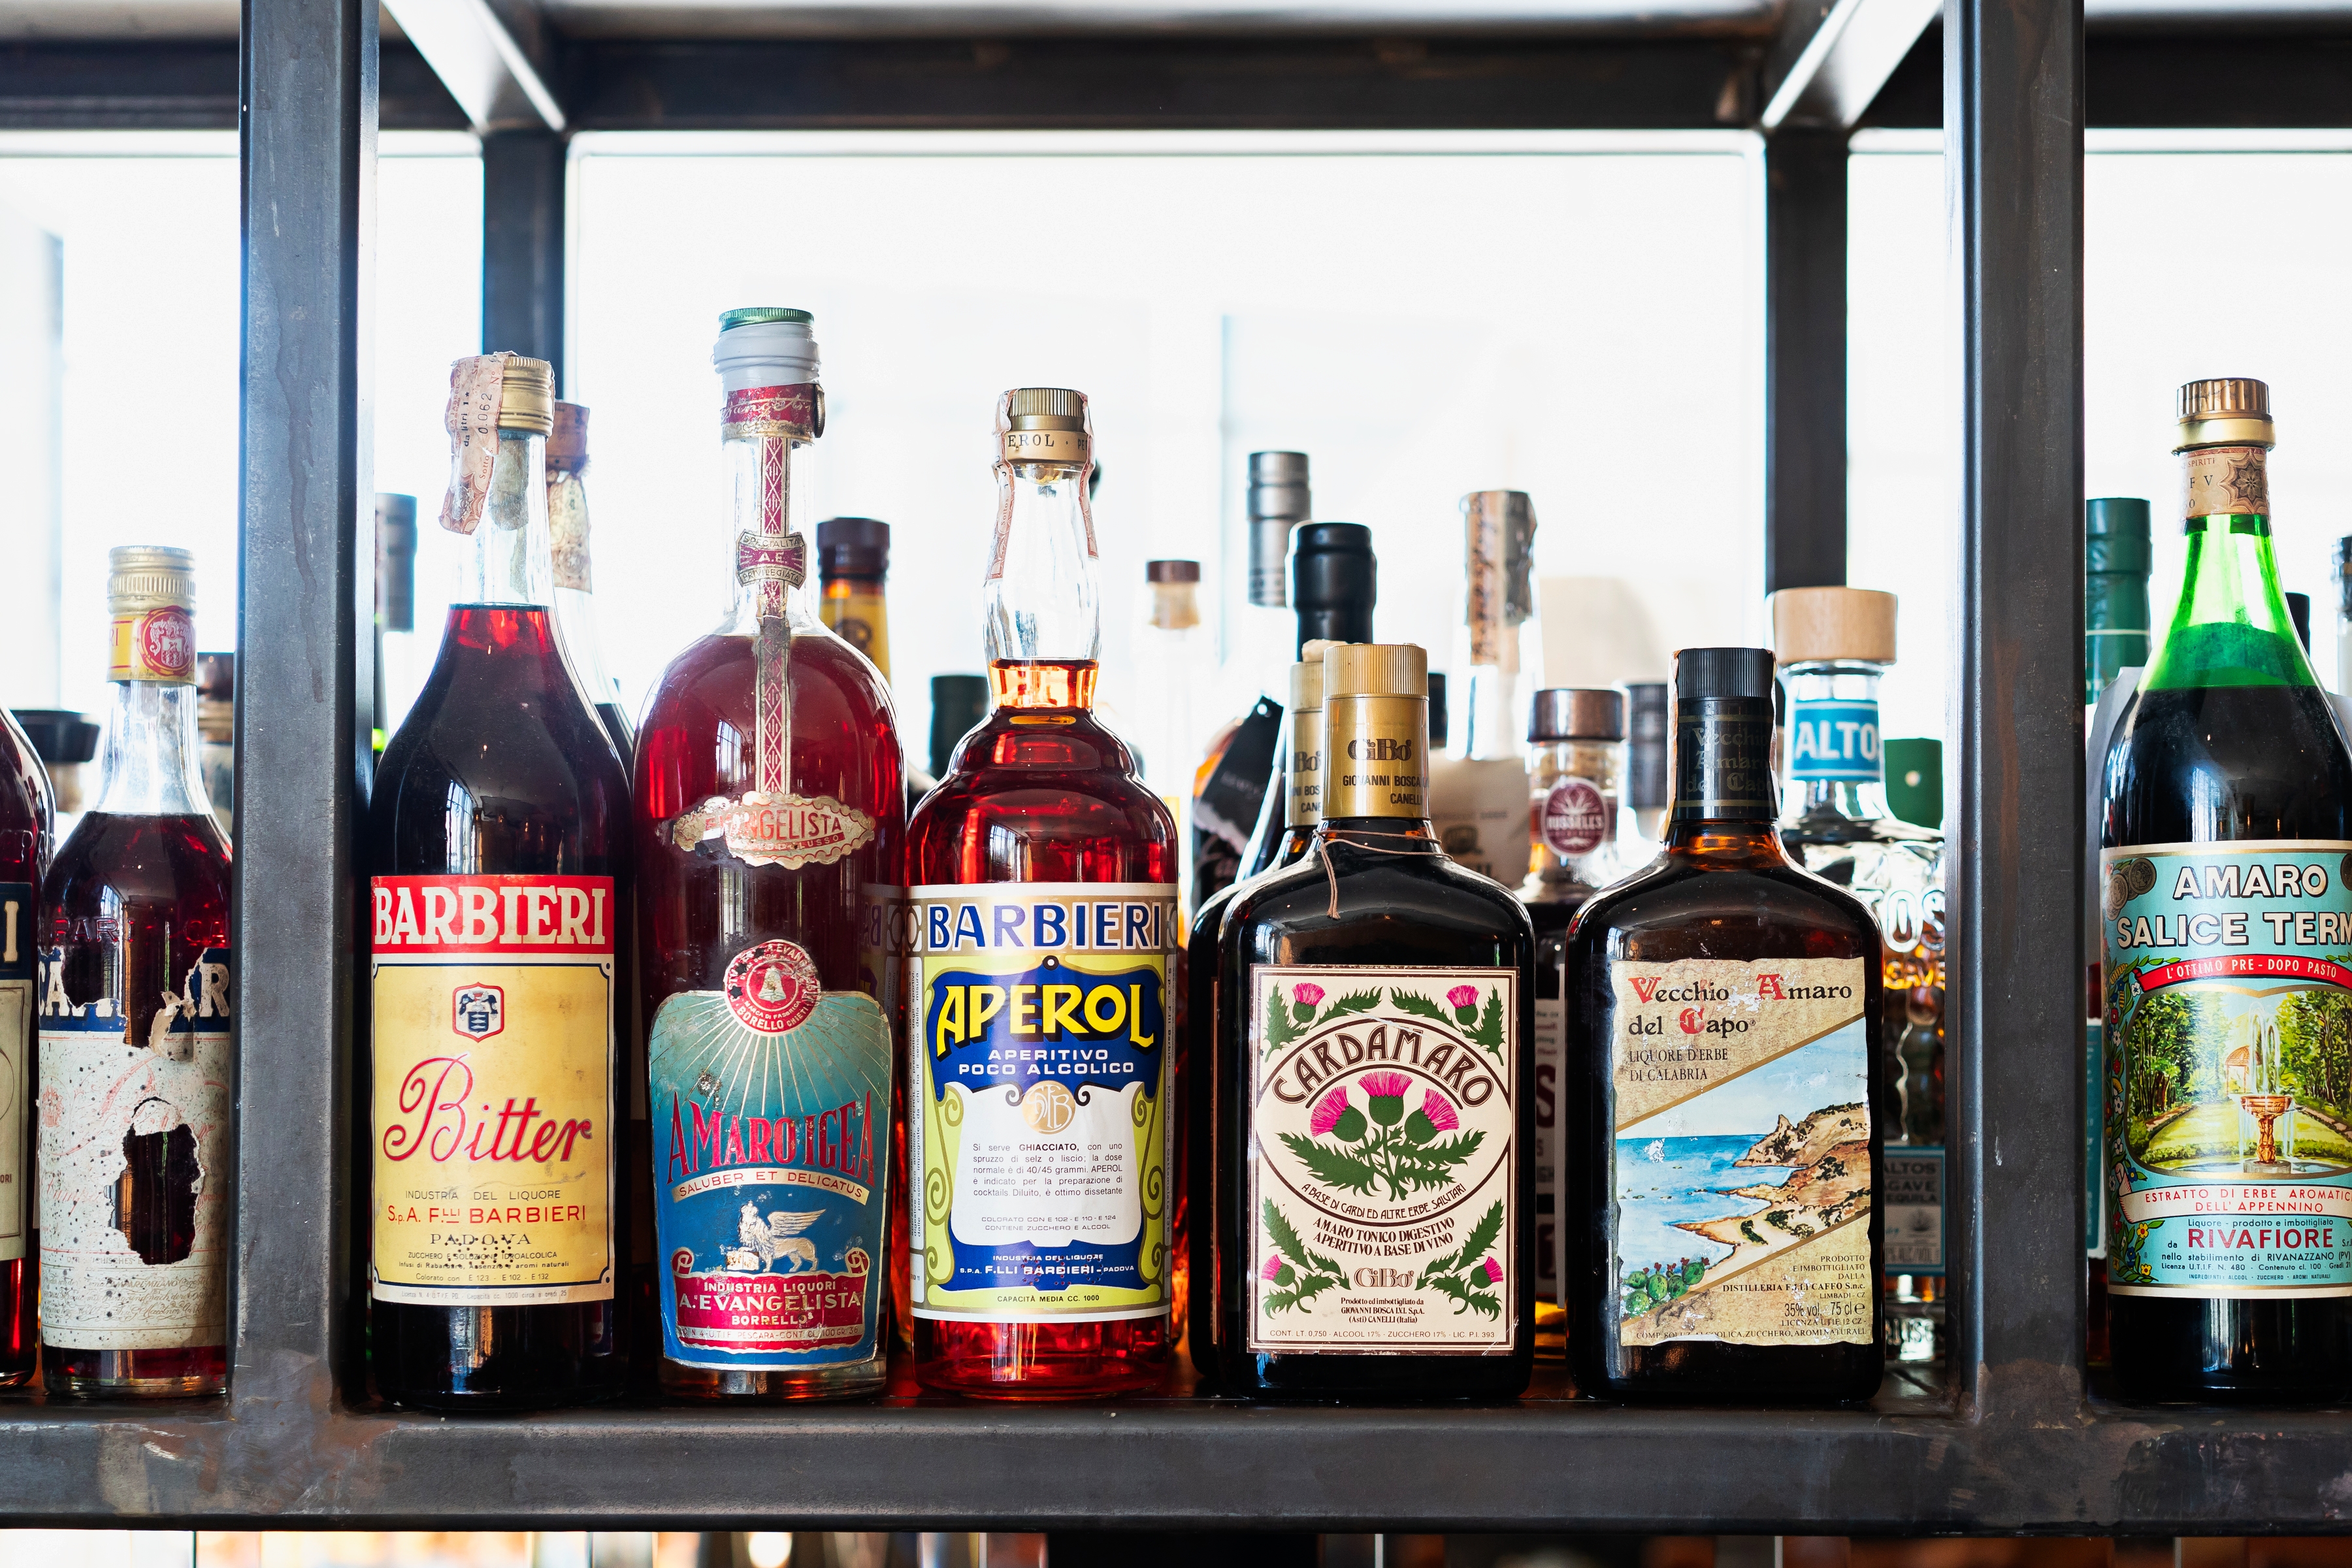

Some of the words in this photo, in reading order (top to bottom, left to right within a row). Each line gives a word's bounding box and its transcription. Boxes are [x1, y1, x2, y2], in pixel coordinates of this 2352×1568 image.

[1343, 775, 1390, 786] GIOVANNI
[2173, 864, 2328, 900] AMARO
[374, 885, 606, 945] BARBIERI
[928, 902, 1161, 951] BARBIERI
[2117, 913, 2249, 949] SALICE
[2167, 960, 2223, 979] L'OTTIMO
[2231, 959, 2254, 971] PRE
[2268, 959, 2300, 971] DOPO
[2307, 961, 2337, 979] PASTO
[1628, 977, 1729, 1004] Vecchio
[1756, 973, 1852, 1001] Amaro
[737, 1006, 784, 1030] BORELLO
[936, 984, 1154, 1057] APEROL
[1628, 1015, 1663, 1035] del
[988, 1049, 1108, 1061] APERITIVO
[1629, 1049, 1683, 1065] LIQUORE
[1688, 1048, 1728, 1060] D'ERBE
[959, 1064, 1016, 1075] POCO
[1027, 1062, 1134, 1075] ALCOLICO
[1272, 1024, 1494, 1107] CARDAMARO
[1630, 1070, 1642, 1082] DI
[1647, 1068, 1708, 1081] CALABRIA
[384, 1053, 593, 1163] Bitter
[666, 1090, 797, 1186] AMARO
[804, 1090, 875, 1188] IGEA
[1019, 1143, 1079, 1152] GHIACCIATO,
[973, 1156, 1004, 1164] spruzzo
[1061, 1154, 1086, 1163] liscio;
[1026, 1166, 1052, 1174] 40/45
[1055, 1166, 1088, 1175] grammi.
[1091, 1164, 1122, 1173] APEROL
[679, 1172, 744, 1197] SALUBER
[756, 1171, 777, 1181] ET
[787, 1172, 864, 1198] DELICATUS
[984, 1177, 1016, 1186] indicato
[1023, 1179, 1036, 1187] per
[1059, 1176, 1111, 1186] preparazione
[406, 1190, 458, 1200] INDUSTRIA
[474, 1192, 497, 1200] DEL
[509, 1190, 561, 1201] LIQUORE
[1013, 1188, 1041, 1198] Diluito,
[1085, 1187, 1122, 1196] dissetante
[2146, 1189, 2209, 1203] ESTRATTO
[2221, 1189, 2235, 1198] DI
[2243, 1189, 2277, 1198] ERBE
[1309, 1189, 1332, 1207] BASE
[1341, 1204, 1366, 1218] CARDI
[1380, 1209, 1407, 1219] ALTRE
[1408, 1204, 1430, 1217] ERBE
[1433, 1183, 1467, 1209] SALUTARI
[2195, 1201, 2232, 1212] DELL'
[2238, 1201, 2323, 1213] APPENNINO
[387, 1205, 421, 1225] S.p.A.
[470, 1205, 585, 1224] BARBIERI
[1313, 1217, 1354, 1239] AMARO
[1356, 1230, 1396, 1243] TONICO
[1399, 1217, 1455, 1242] DIGESTIVO
[2188, 1219, 2221, 1228] Liquore
[2232, 1219, 2272, 1228] prodotto
[2284, 1218, 2334, 1228] imbottigliato
[430, 1233, 532, 1245] PADOVA
[1313, 1232, 1373, 1256] APERITIVO
[1384, 1244, 1411, 1256] BASE
[1426, 1232, 1454, 1250] VINO
[2167, 1240, 2178, 1249] da
[2188, 1228, 2333, 1249] RIVAFIORE
[2162, 1252, 2182, 1261] nello
[2188, 1253, 2244, 1262] stabilimento
[2267, 1252, 2334, 1262] RIVANAZZANO
[2338, 1251, 2351, 1262] (PV)
[985, 1266, 1017, 1275] F.LLI
[784, 1281, 836, 1292] LIQUORI
[997, 1294, 1036, 1303] CAPACITÀ
[1341, 1297, 1367, 1305] Prodotto
[1376, 1297, 1416, 1306] imbottigliato
[1408, 1307, 1424, 1316] S.p.A.
[1784, 1303, 1804, 1316] 35%
[1831, 1301, 1842, 1315] 75
[1349, 1316, 1366, 1324] (Asti)
[1397, 1316, 1418, 1324] (Italia)
